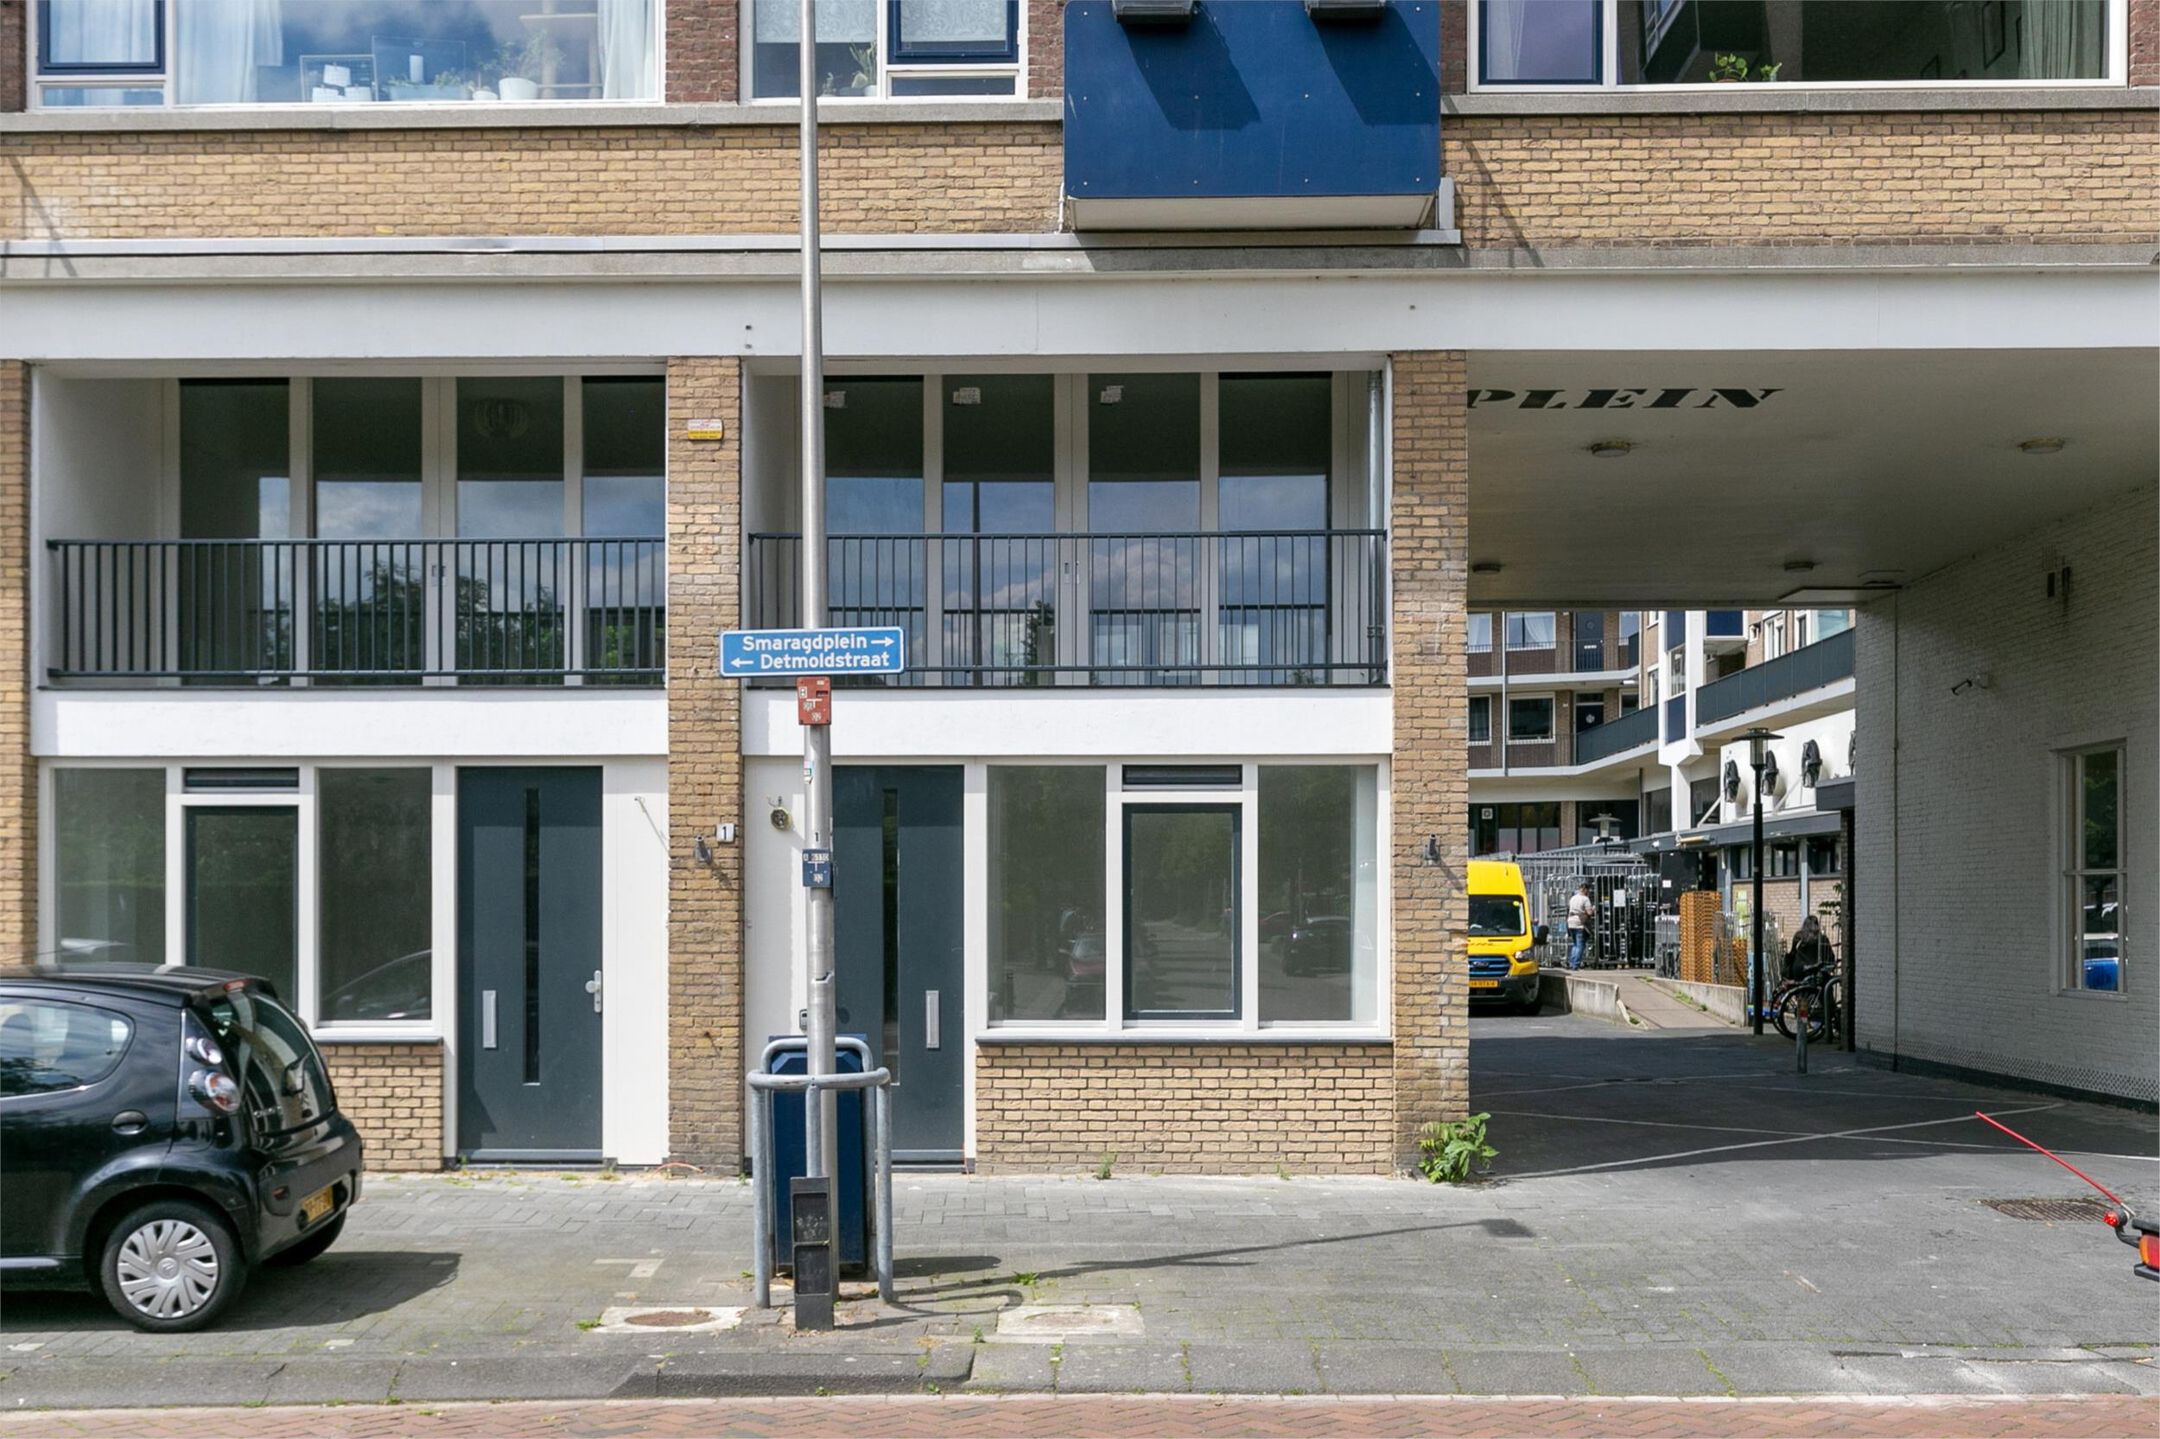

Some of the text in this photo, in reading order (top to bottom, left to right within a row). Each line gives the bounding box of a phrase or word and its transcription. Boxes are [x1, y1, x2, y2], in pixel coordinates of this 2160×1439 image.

[1467, 388, 1785, 409] PLEIN
[742, 634, 868, 655] Smaragdplein
[760, 652, 890, 670] Detmoldstraat
[722, 826, 728, 841] 1
